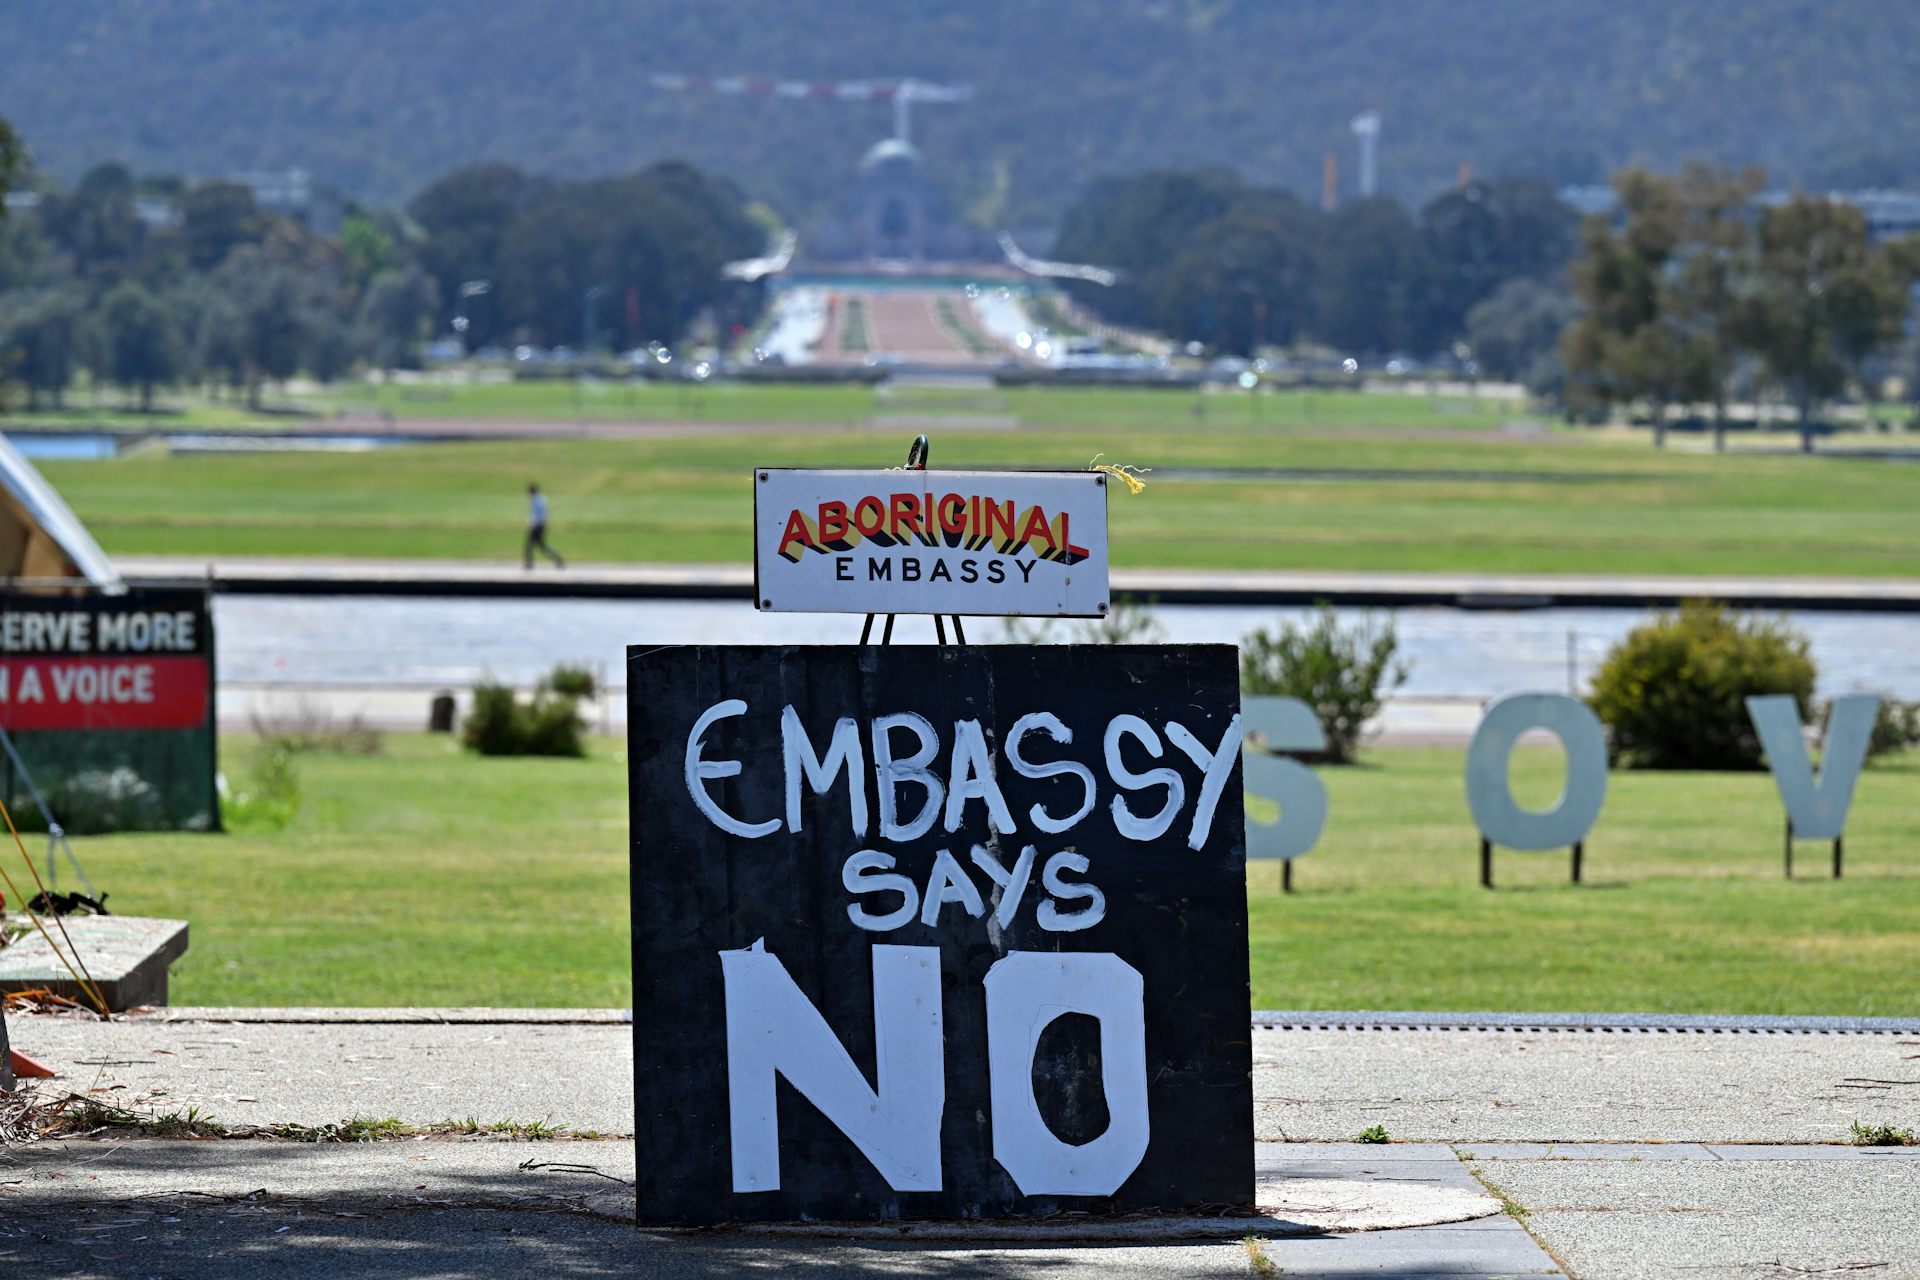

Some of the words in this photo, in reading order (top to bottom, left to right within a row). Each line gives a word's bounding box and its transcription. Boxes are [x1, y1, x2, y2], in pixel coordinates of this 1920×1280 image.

[777, 492, 1090, 565] ABORIGINAL
[836, 556, 1038, 584] EMBASSY
[97, 610, 196, 650] MORE
[17, 665, 44, 704] A
[51, 664, 155, 704] VOICE
[684, 699, 1242, 850] EMBASSY
[841, 843, 1107, 933] SAYS
[718, 936, 1151, 1198] NO
